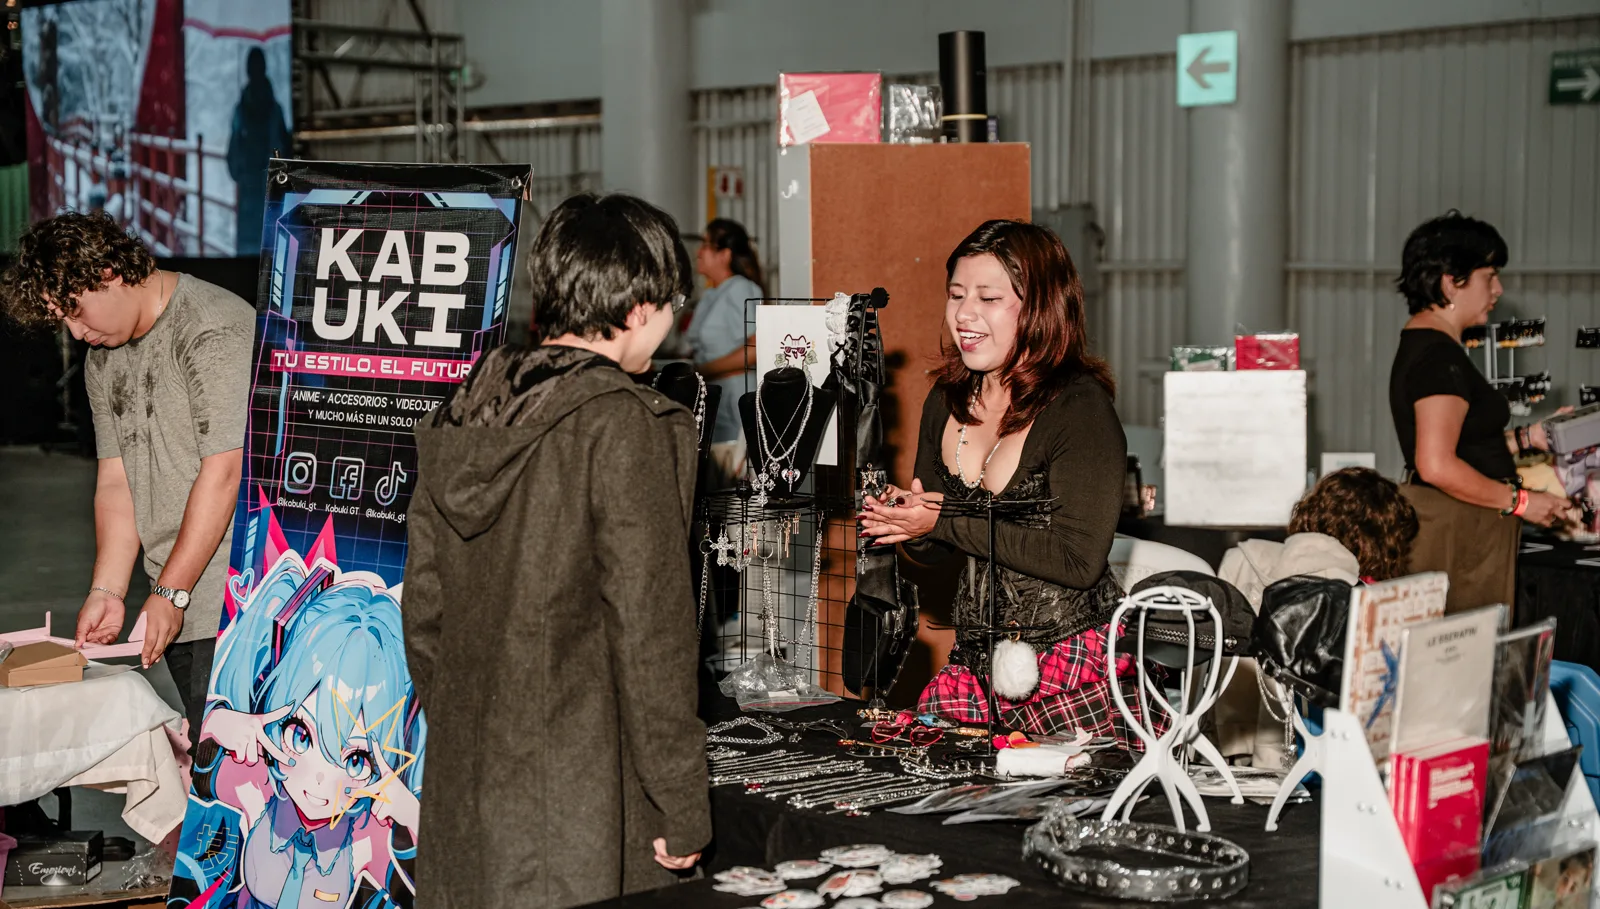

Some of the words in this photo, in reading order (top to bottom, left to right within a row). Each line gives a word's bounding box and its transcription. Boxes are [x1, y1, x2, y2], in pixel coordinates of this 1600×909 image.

[316, 227, 470, 286] KAB
[312, 287, 467, 348] UKI
[274, 352, 298, 367] TU
[380, 359, 404, 375] EL
[410, 361, 473, 378] FUTUR
[292, 390, 320, 403] ANIME
[327, 393, 388, 408] ACCESORIOS
[395, 398, 443, 412] VIDEOJUE
[308, 409, 314, 419] Y
[315, 410, 345, 422] MUCHO
[346, 411, 365, 424] MÁS
[365, 414, 376, 425] EN
[377, 415, 390, 426] UN
[390, 416, 413, 428] SOLO
[277, 497, 317, 512] @kabuki_gt
[325, 504, 349, 514] Kabuki
[349, 506, 360, 515] GT
[366, 508, 406, 523] @kabuki_gt
